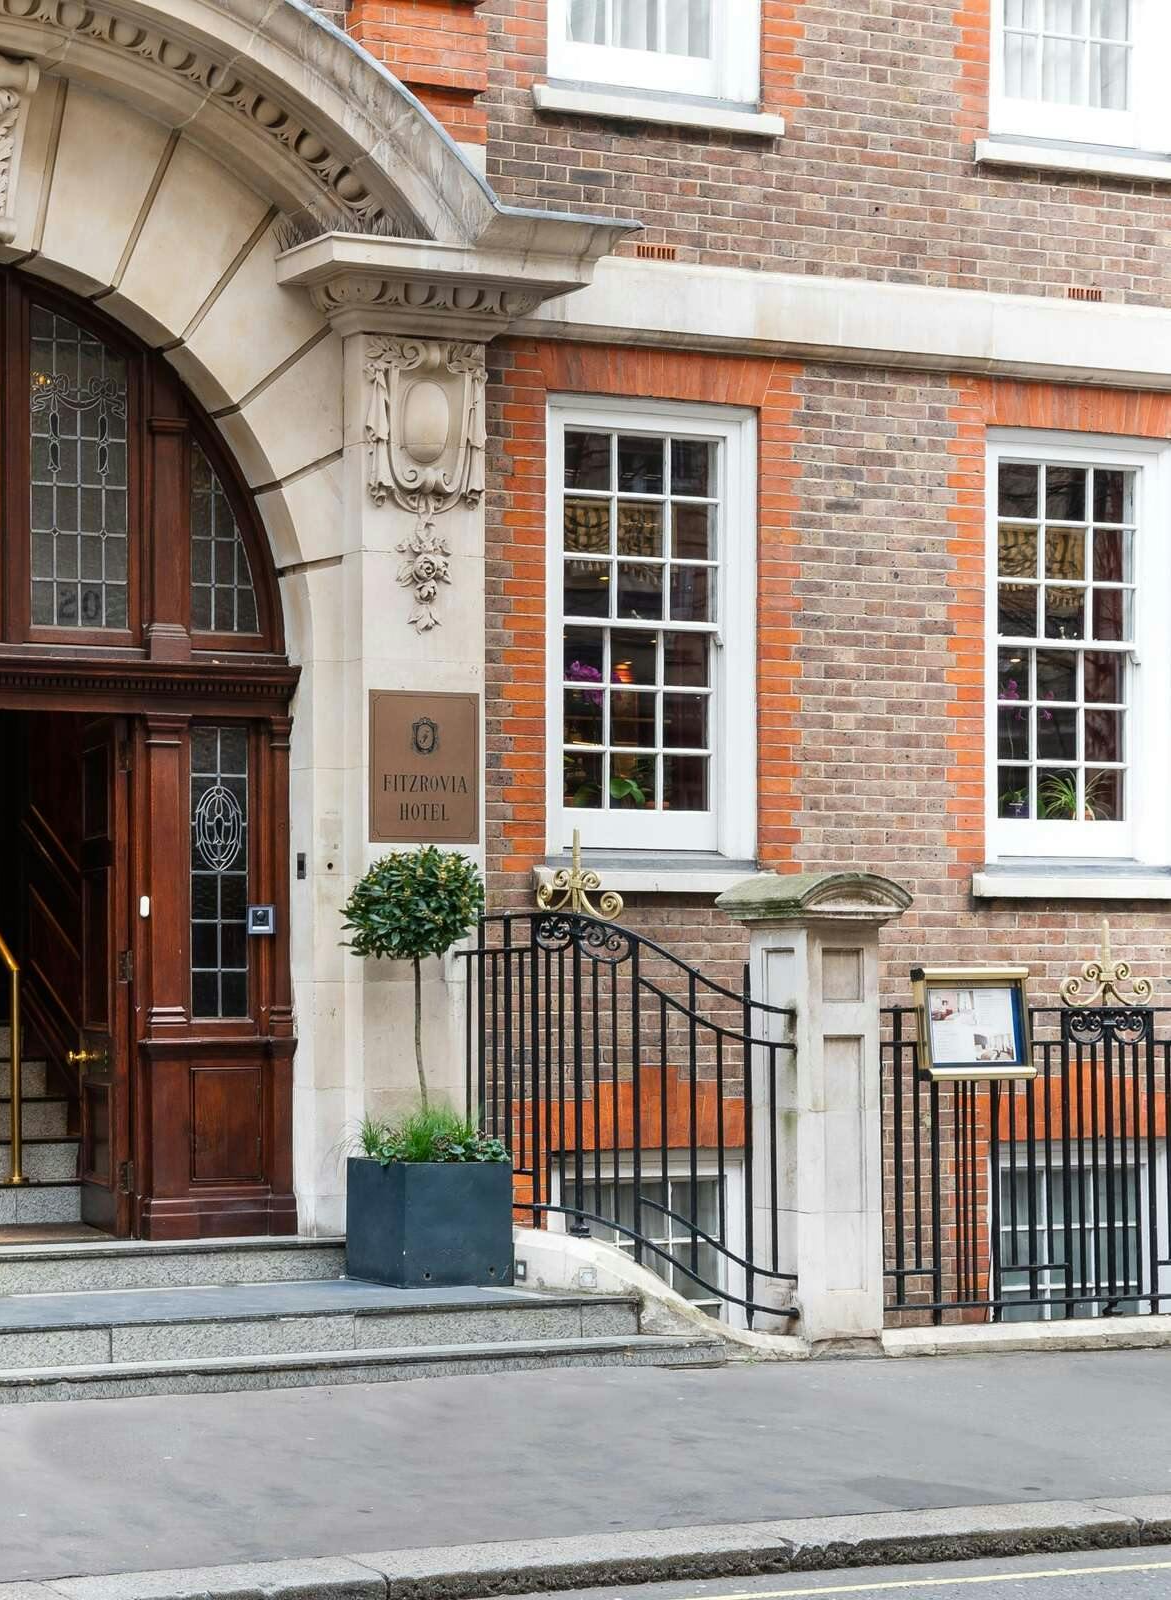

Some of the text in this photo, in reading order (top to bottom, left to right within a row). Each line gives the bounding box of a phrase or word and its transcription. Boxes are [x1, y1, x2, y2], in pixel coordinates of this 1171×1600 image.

[59, 590, 101, 619] 20
[383, 774, 468, 794] FITZROVIA
[399, 802, 450, 821] HOTEL
